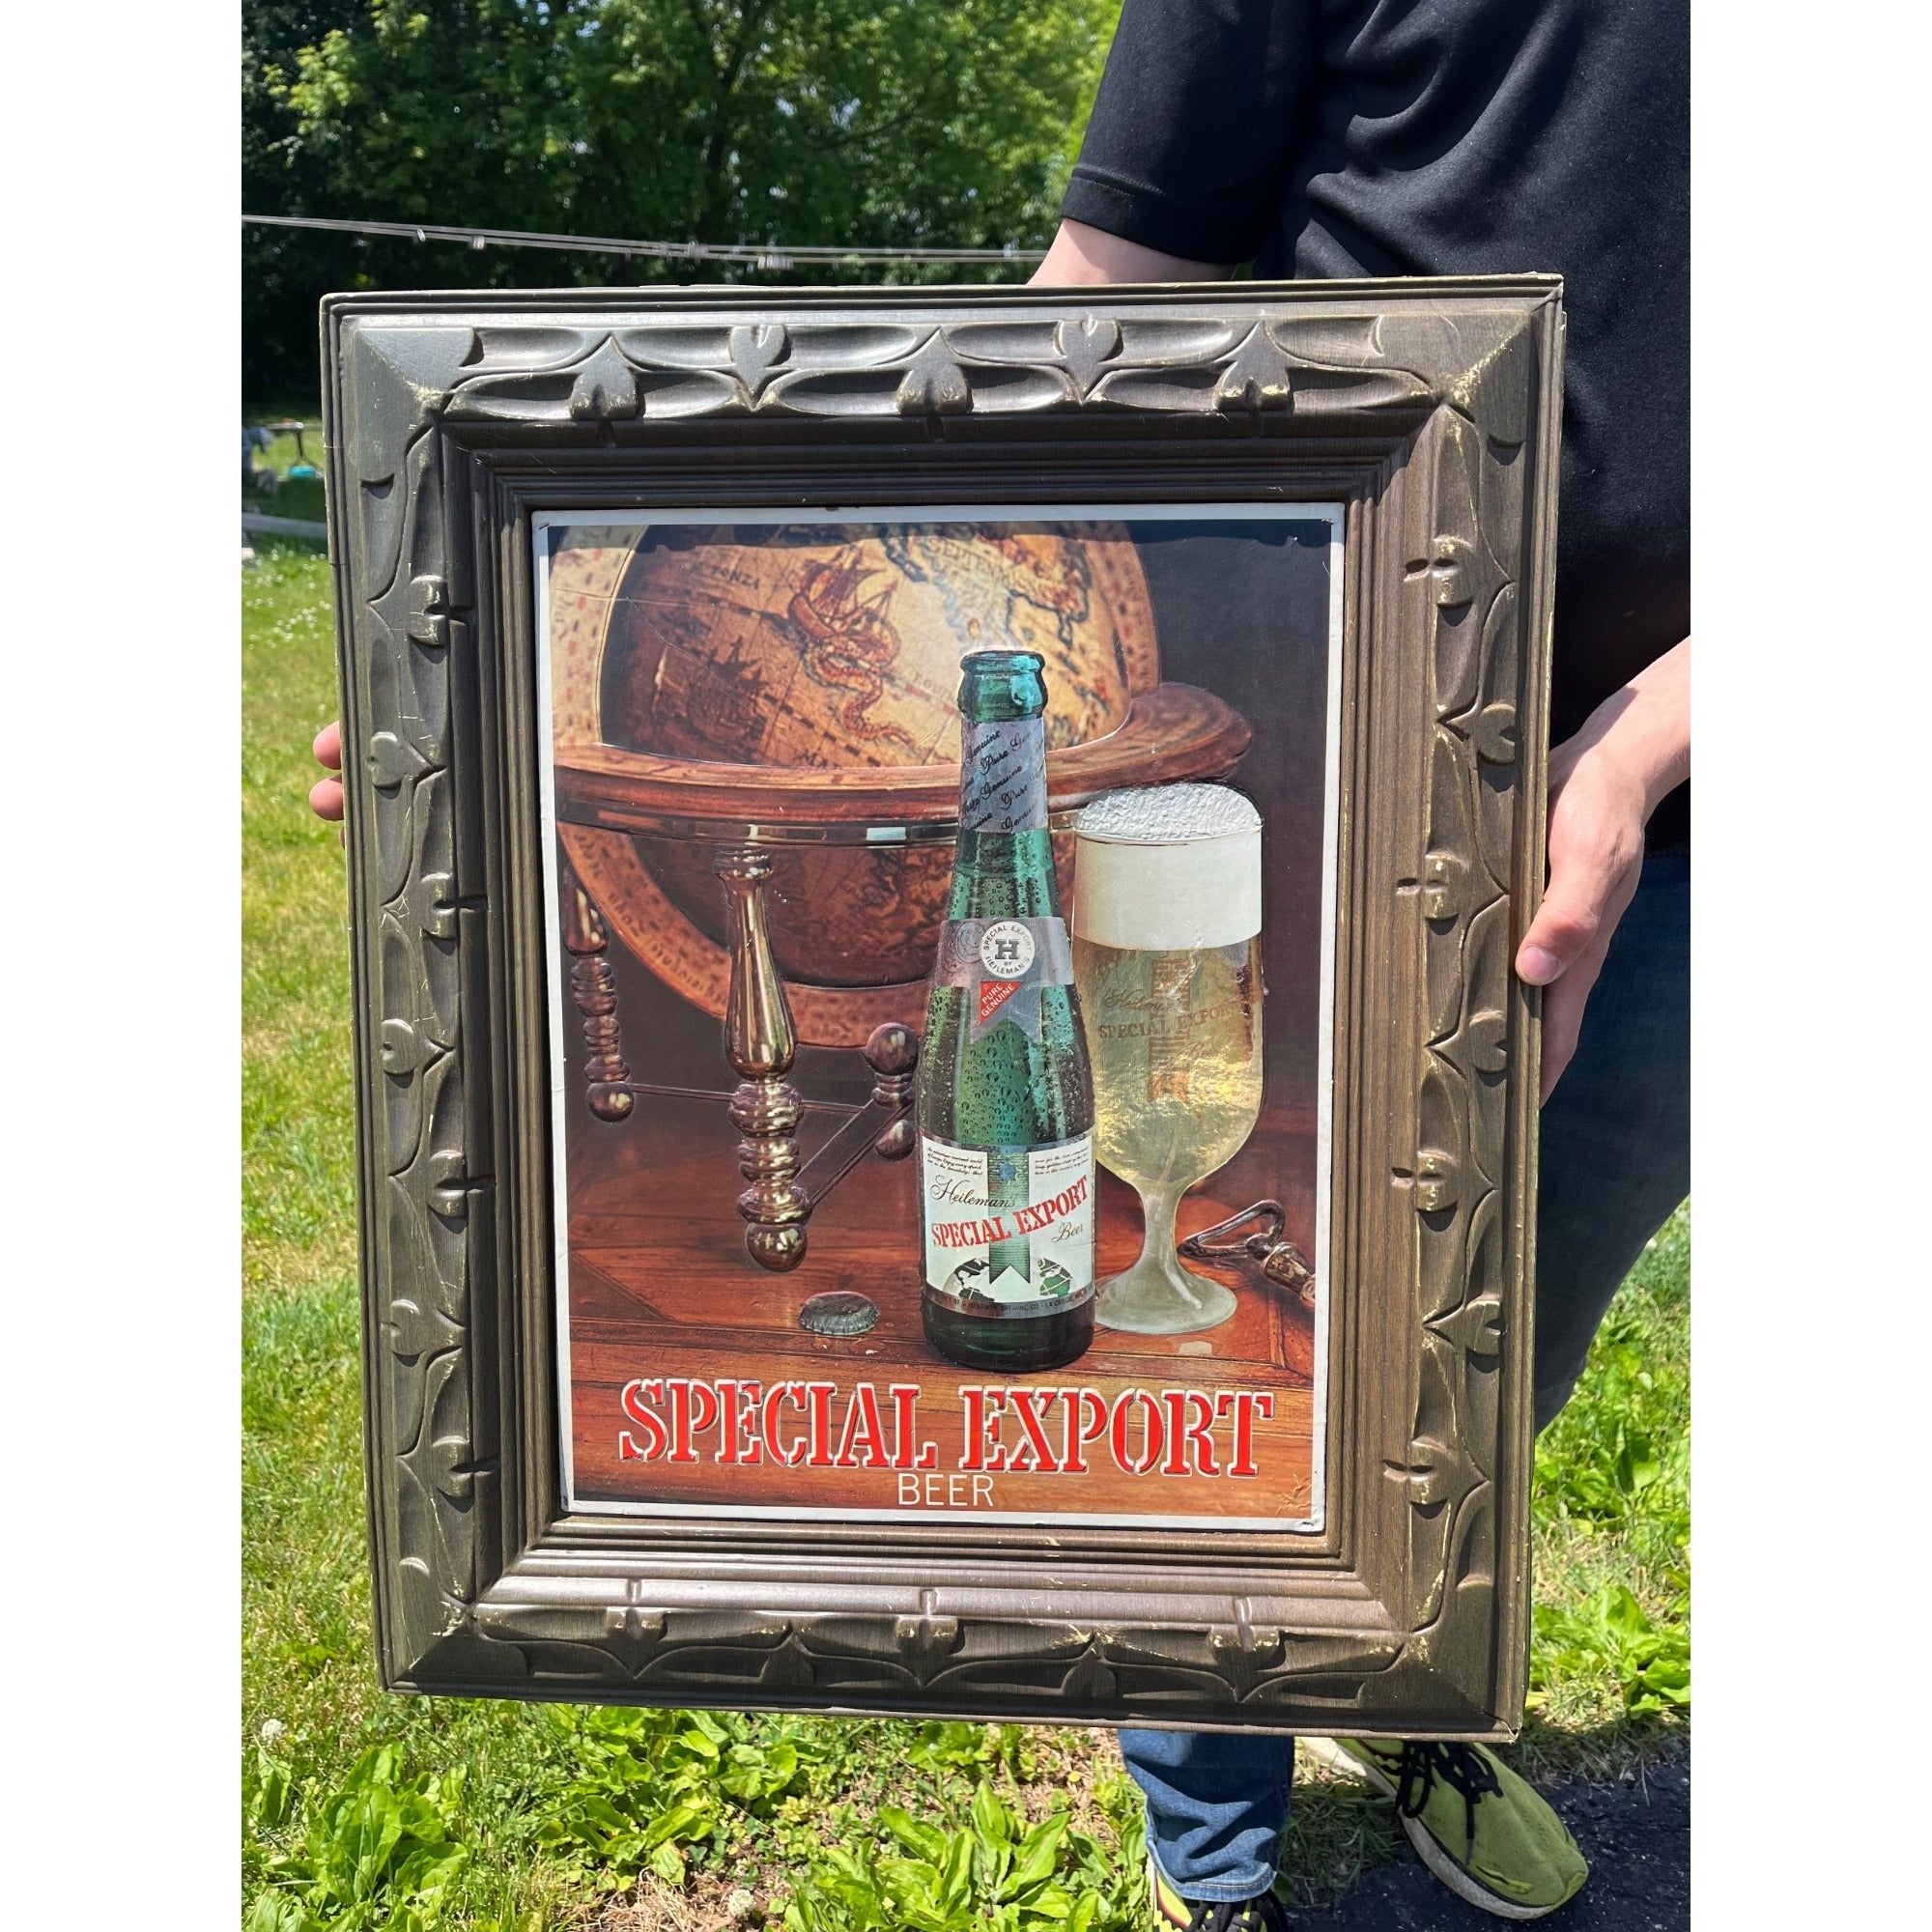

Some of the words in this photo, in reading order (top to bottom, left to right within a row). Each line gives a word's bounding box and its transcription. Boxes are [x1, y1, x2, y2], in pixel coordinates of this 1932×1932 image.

[983, 924, 1008, 952] SPECIAL
[1010, 924, 1033, 952] EXPORT
[994, 938, 1020, 960] H
[981, 982, 1004, 1005] PURE
[981, 982, 1016, 1016] GENUINE
[1098, 1019, 1171, 1039] SPECIAL
[931, 1215, 1012, 1248] SPECIAL
[1012, 1175, 1089, 1236] EXPORT
[1050, 1221, 1084, 1243] Beer
[619, 1378, 939, 1469] SPECIAL
[958, 1385, 1275, 1479] EXPORT
[897, 1473, 995, 1507] BEER
